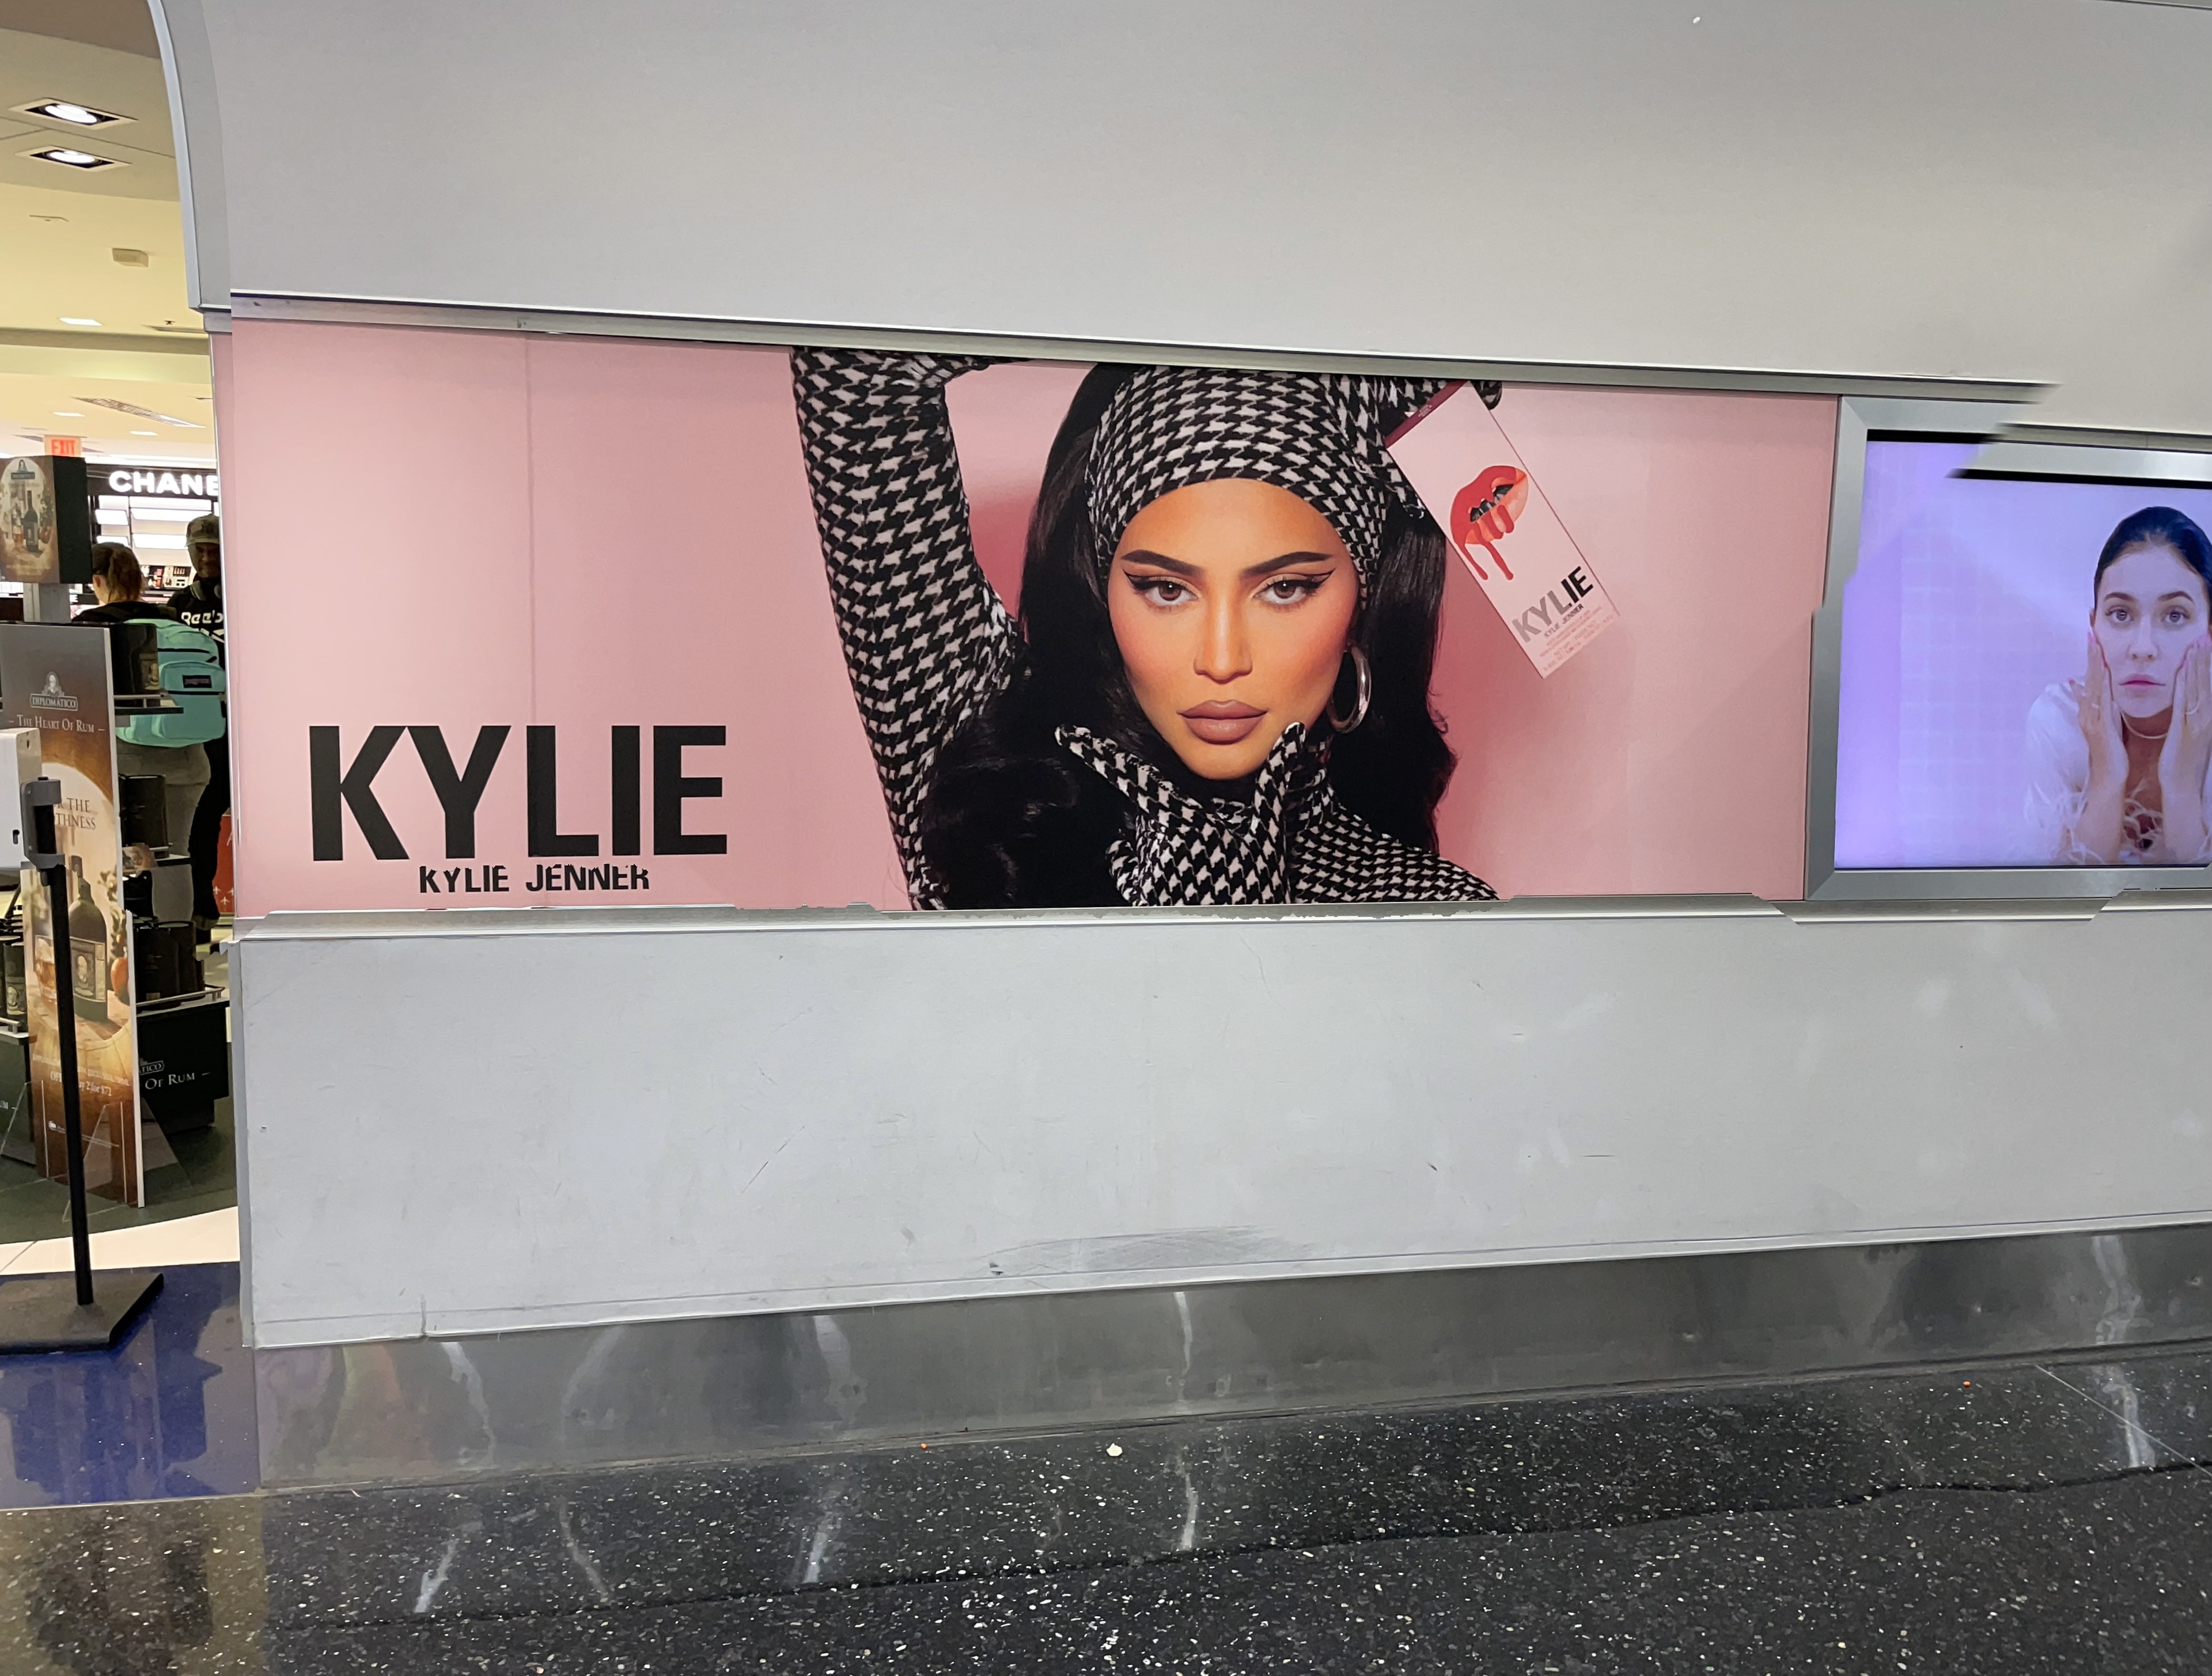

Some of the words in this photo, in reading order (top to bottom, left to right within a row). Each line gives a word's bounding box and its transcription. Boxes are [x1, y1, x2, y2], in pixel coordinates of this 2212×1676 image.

[51, 439, 75, 456] EXIT
[1512, 566, 1593, 643] KYLIE
[309, 725, 728, 861] KYLIE
[66, 797, 90, 813] THE
[419, 865, 509, 893] KYLIE
[525, 863, 650, 892] JENNER
[168, 1072, 195, 1086] RUM
